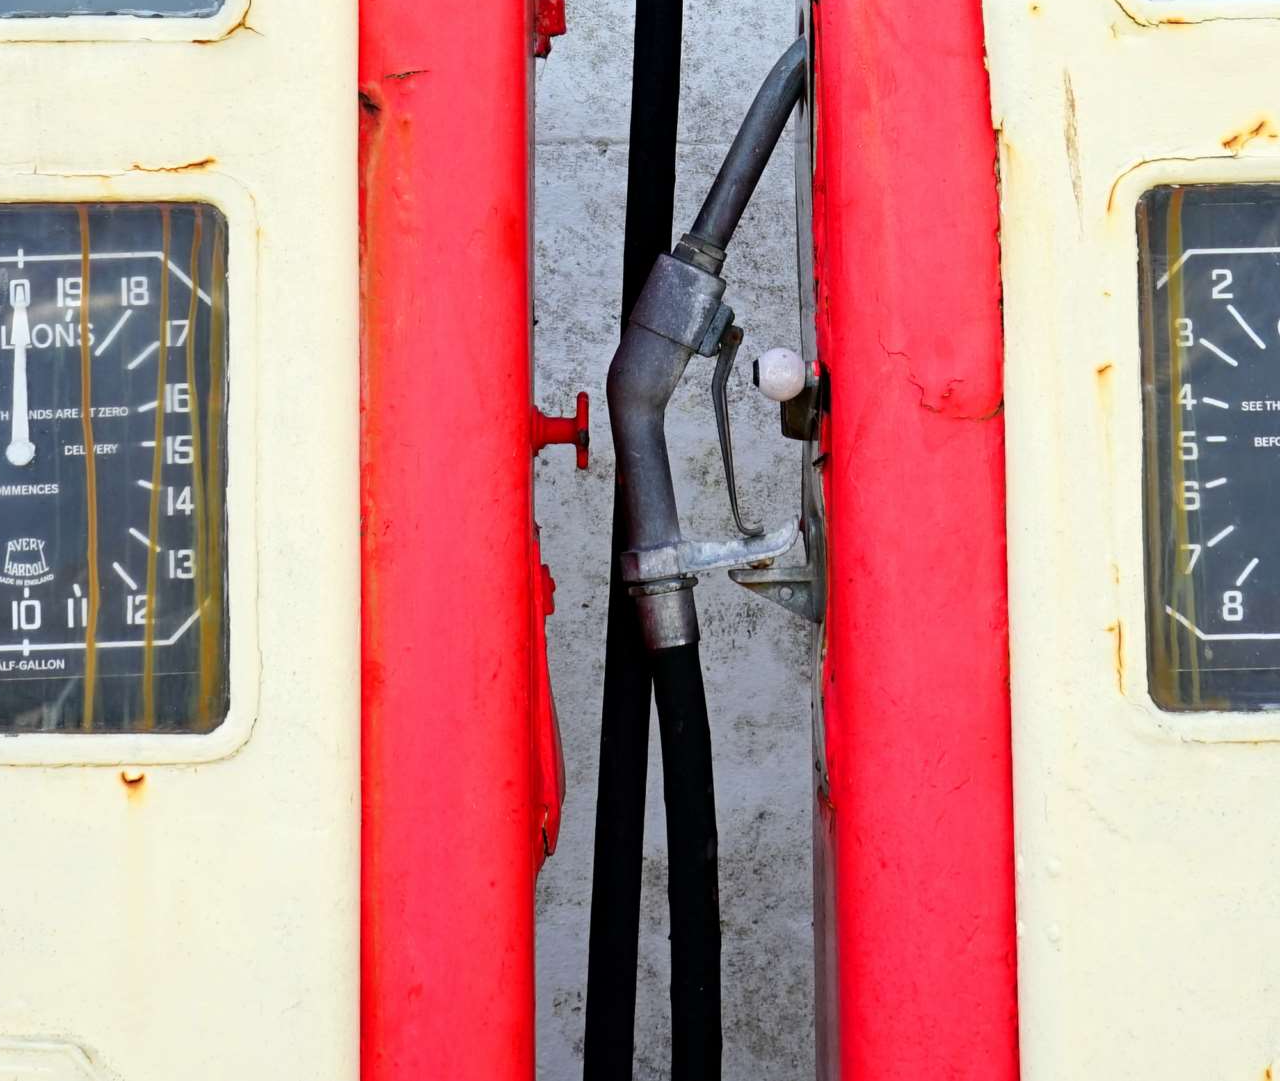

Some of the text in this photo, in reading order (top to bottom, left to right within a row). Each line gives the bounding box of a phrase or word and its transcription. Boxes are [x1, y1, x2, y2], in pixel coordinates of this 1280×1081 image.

[56, 277, 83, 307] 19
[121, 276, 150, 306] 18
[1211, 269, 1233, 299] 2
[165, 320, 190, 347] 17
[1175, 318, 1194, 347] 3
[165, 383, 191, 413] 16
[1178, 383, 1197, 410] 4
[1241, 401, 1263, 411] SEE
[55, 408, 79, 419] ARE
[80, 407, 96, 418] T
[98, 407, 129, 418] ZERO
[64, 444, 118, 456] DELERY
[166, 436, 193, 464] 15
[1178, 431, 1199, 461] 5
[167, 486, 194, 515] 14
[1181, 481, 1200, 511] 6
[7, 538, 45, 552] AVERY
[1181, 544, 1202, 574] 7
[4, 561, 49, 577] HARDOLL
[168, 549, 196, 579] 13
[12, 600, 41, 630] 10
[67, 598, 88, 628] 11
[127, 595, 153, 625] 12
[1222, 590, 1244, 621] 8
